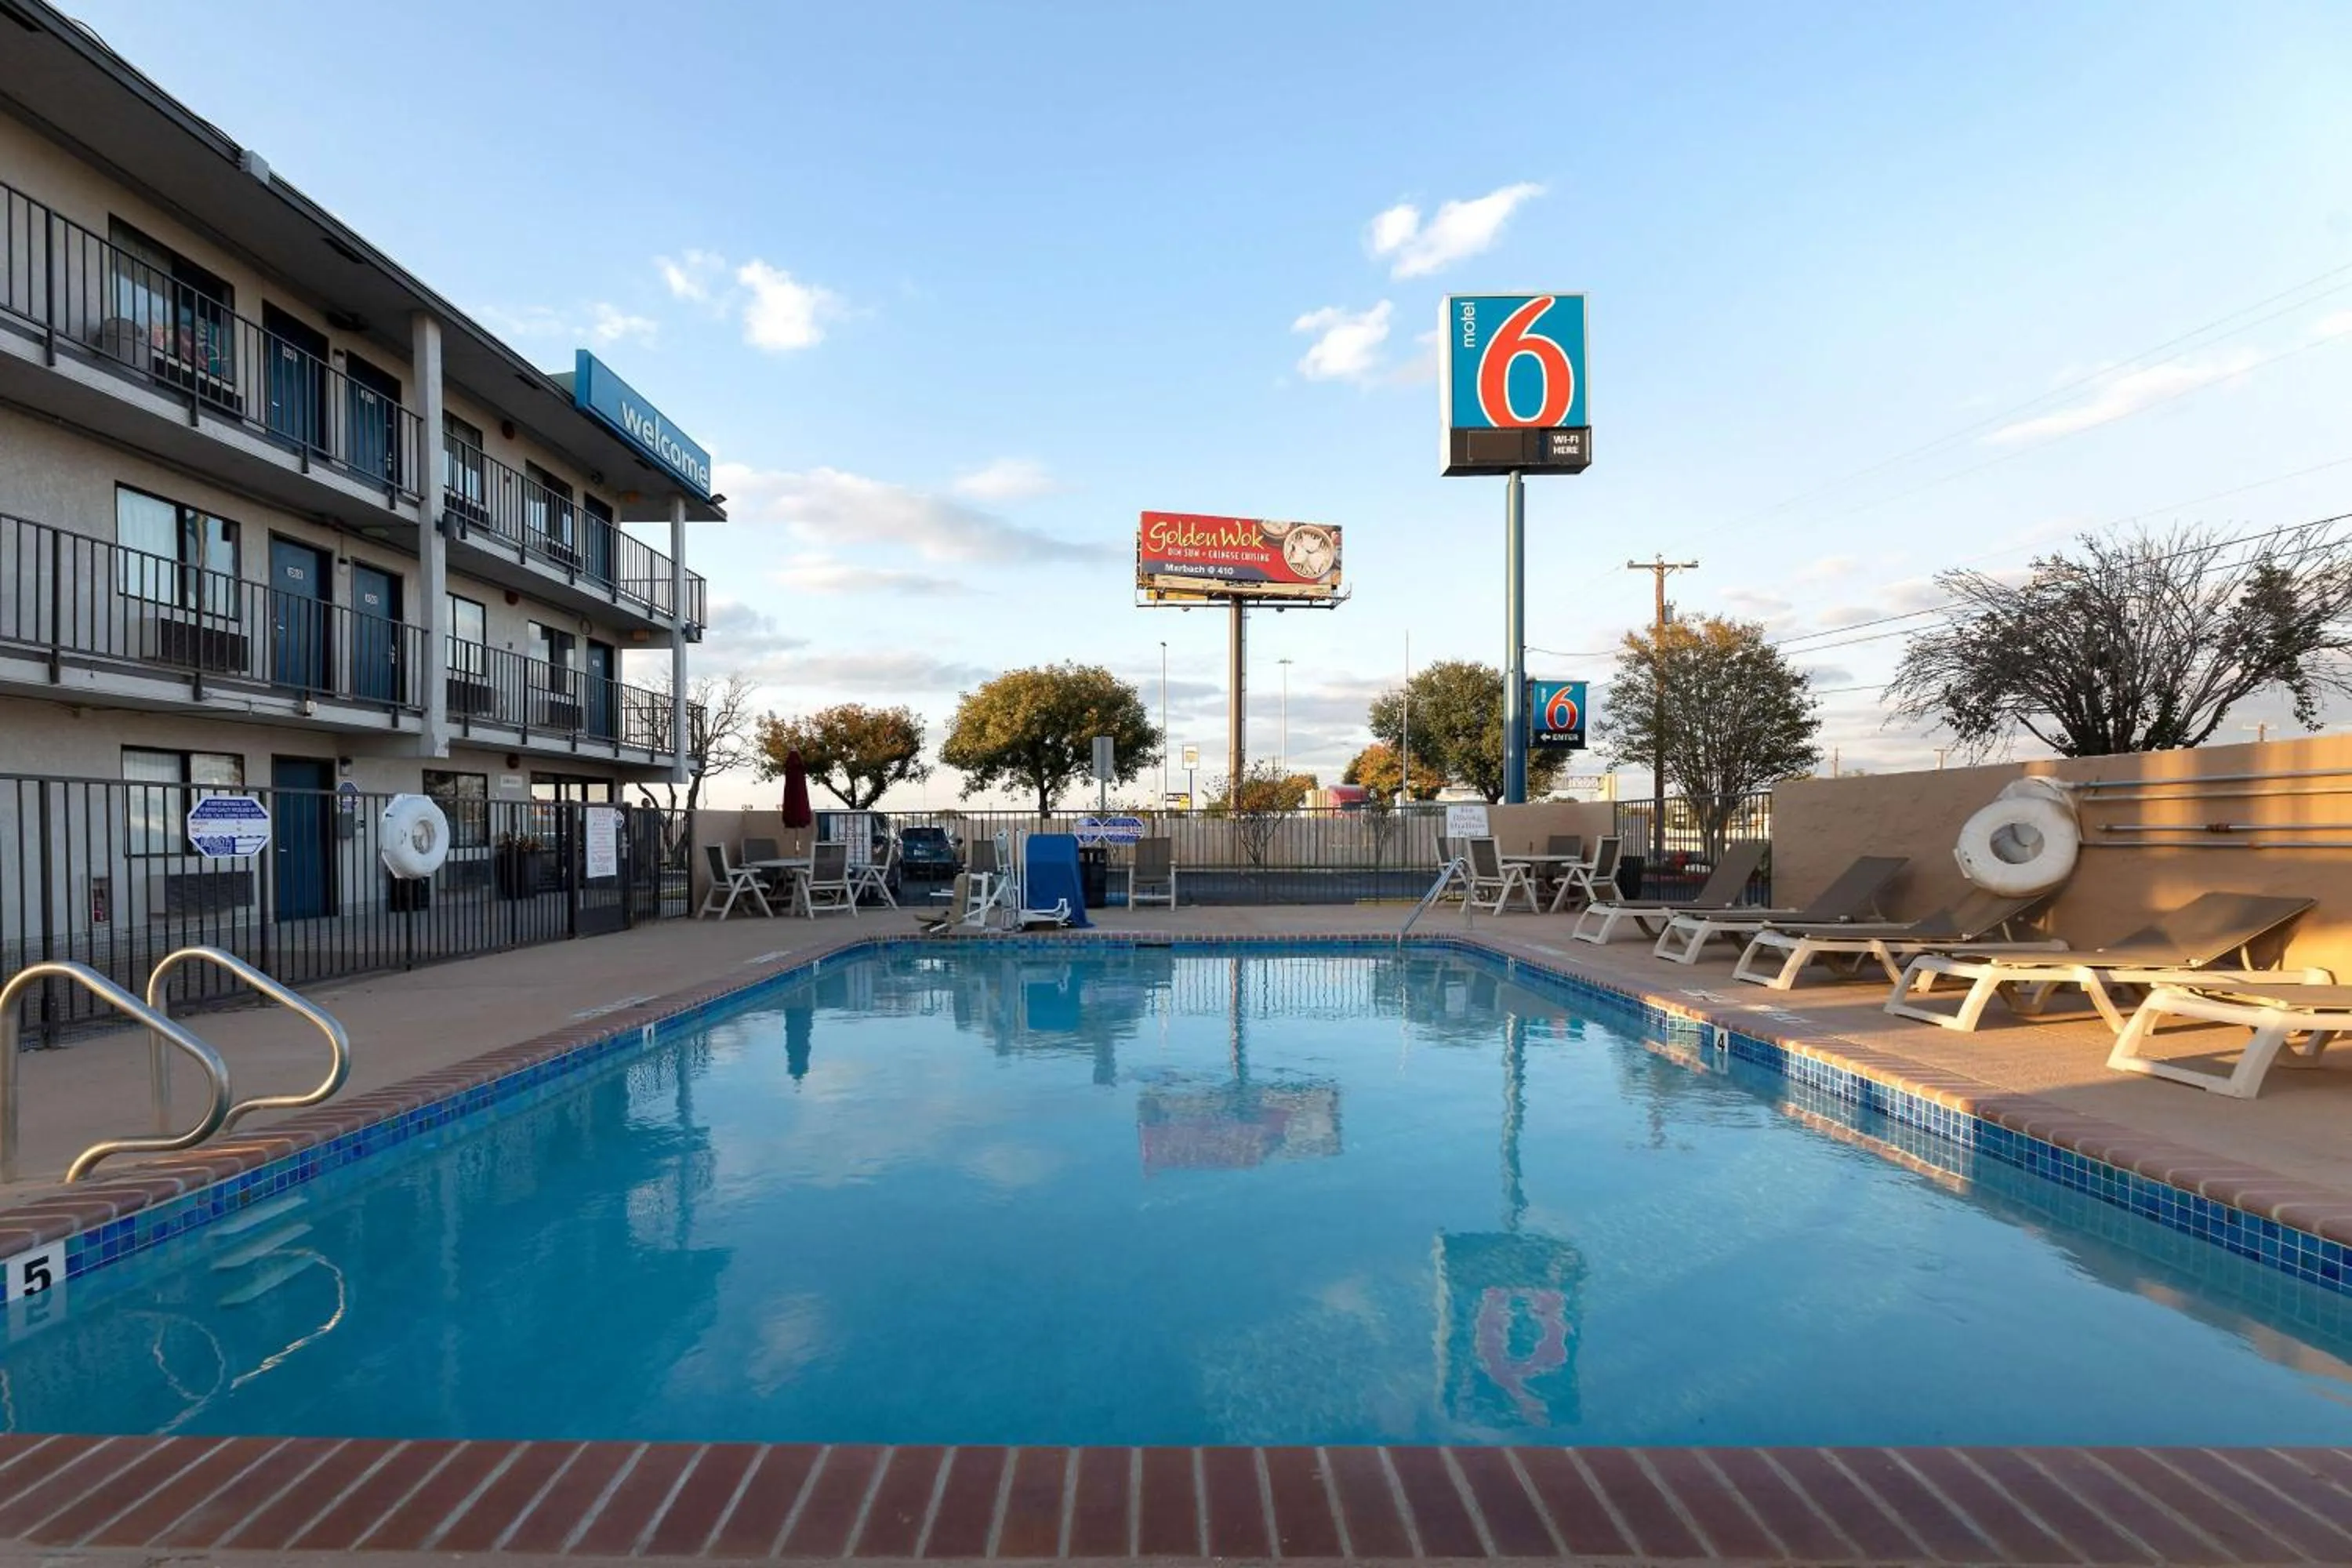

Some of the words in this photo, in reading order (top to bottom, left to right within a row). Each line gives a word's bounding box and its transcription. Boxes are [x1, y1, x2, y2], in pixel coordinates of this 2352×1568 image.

[1460, 302, 1475, 348] motel
[1477, 296, 1574, 427] 6
[621, 401, 710, 488] welcome
[1553, 434, 1579, 445] WI-FI
[1553, 445, 1579, 455] HERE
[1146, 521, 1218, 552] Golden
[1221, 521, 1264, 550] Wok
[1164, 563, 1205, 574] Marbach
[1217, 566, 1234, 575] 410
[1545, 686, 1578, 733] 6
[1718, 1033, 1725, 1052] 4
[24, 1254, 52, 1297] 5
